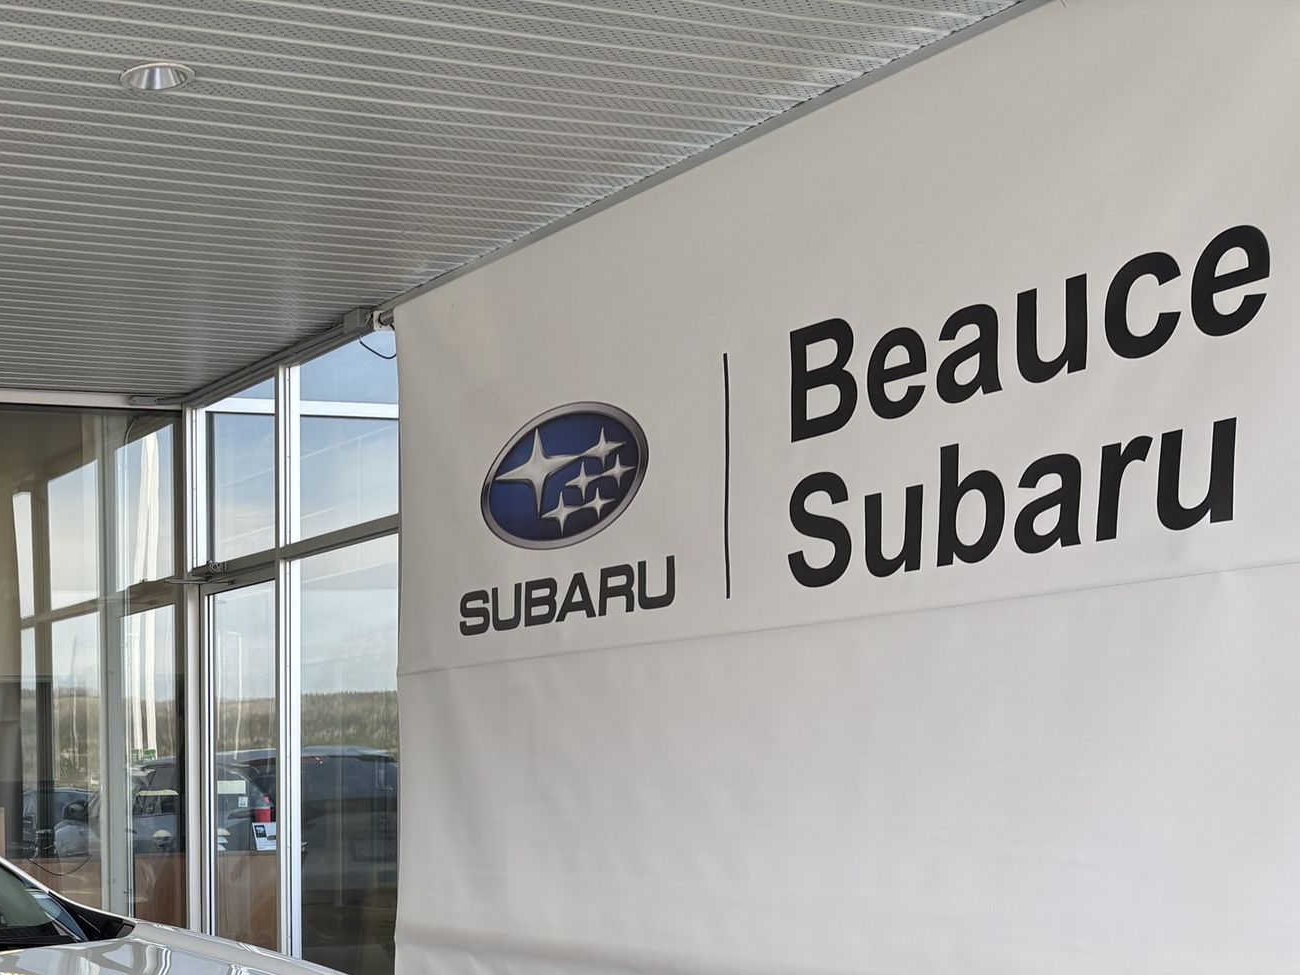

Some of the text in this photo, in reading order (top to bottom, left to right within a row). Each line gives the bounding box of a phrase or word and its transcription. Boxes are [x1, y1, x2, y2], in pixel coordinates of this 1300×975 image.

[789, 224, 1272, 443] Beauce
[787, 416, 1238, 588] Subaru
[459, 554, 677, 637] SUBARU
